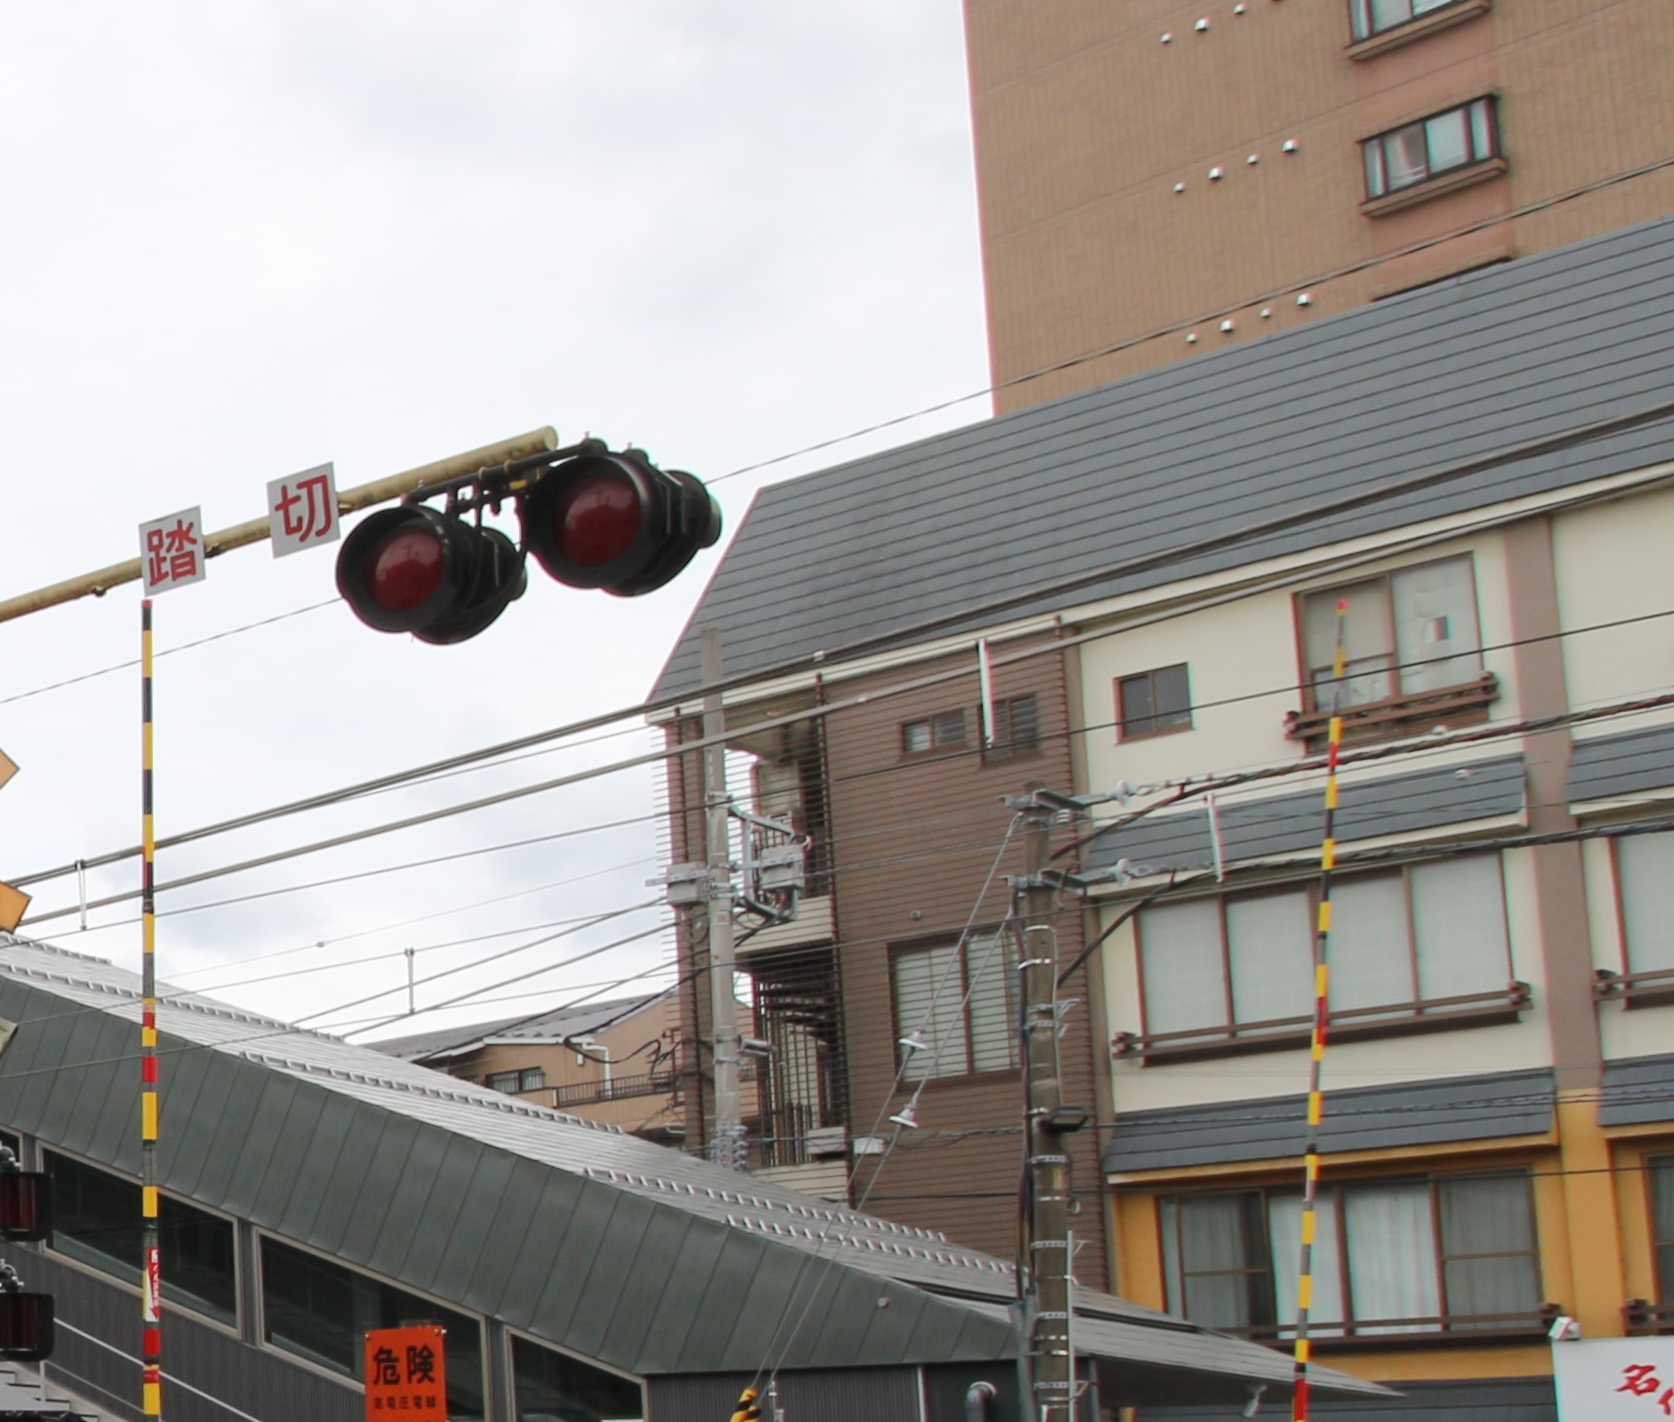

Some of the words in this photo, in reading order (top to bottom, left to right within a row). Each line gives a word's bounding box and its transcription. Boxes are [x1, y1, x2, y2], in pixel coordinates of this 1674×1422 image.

[274, 474, 332, 542] 切
[146, 518, 198, 587] 踏
[372, 1345, 436, 1386] 危険
